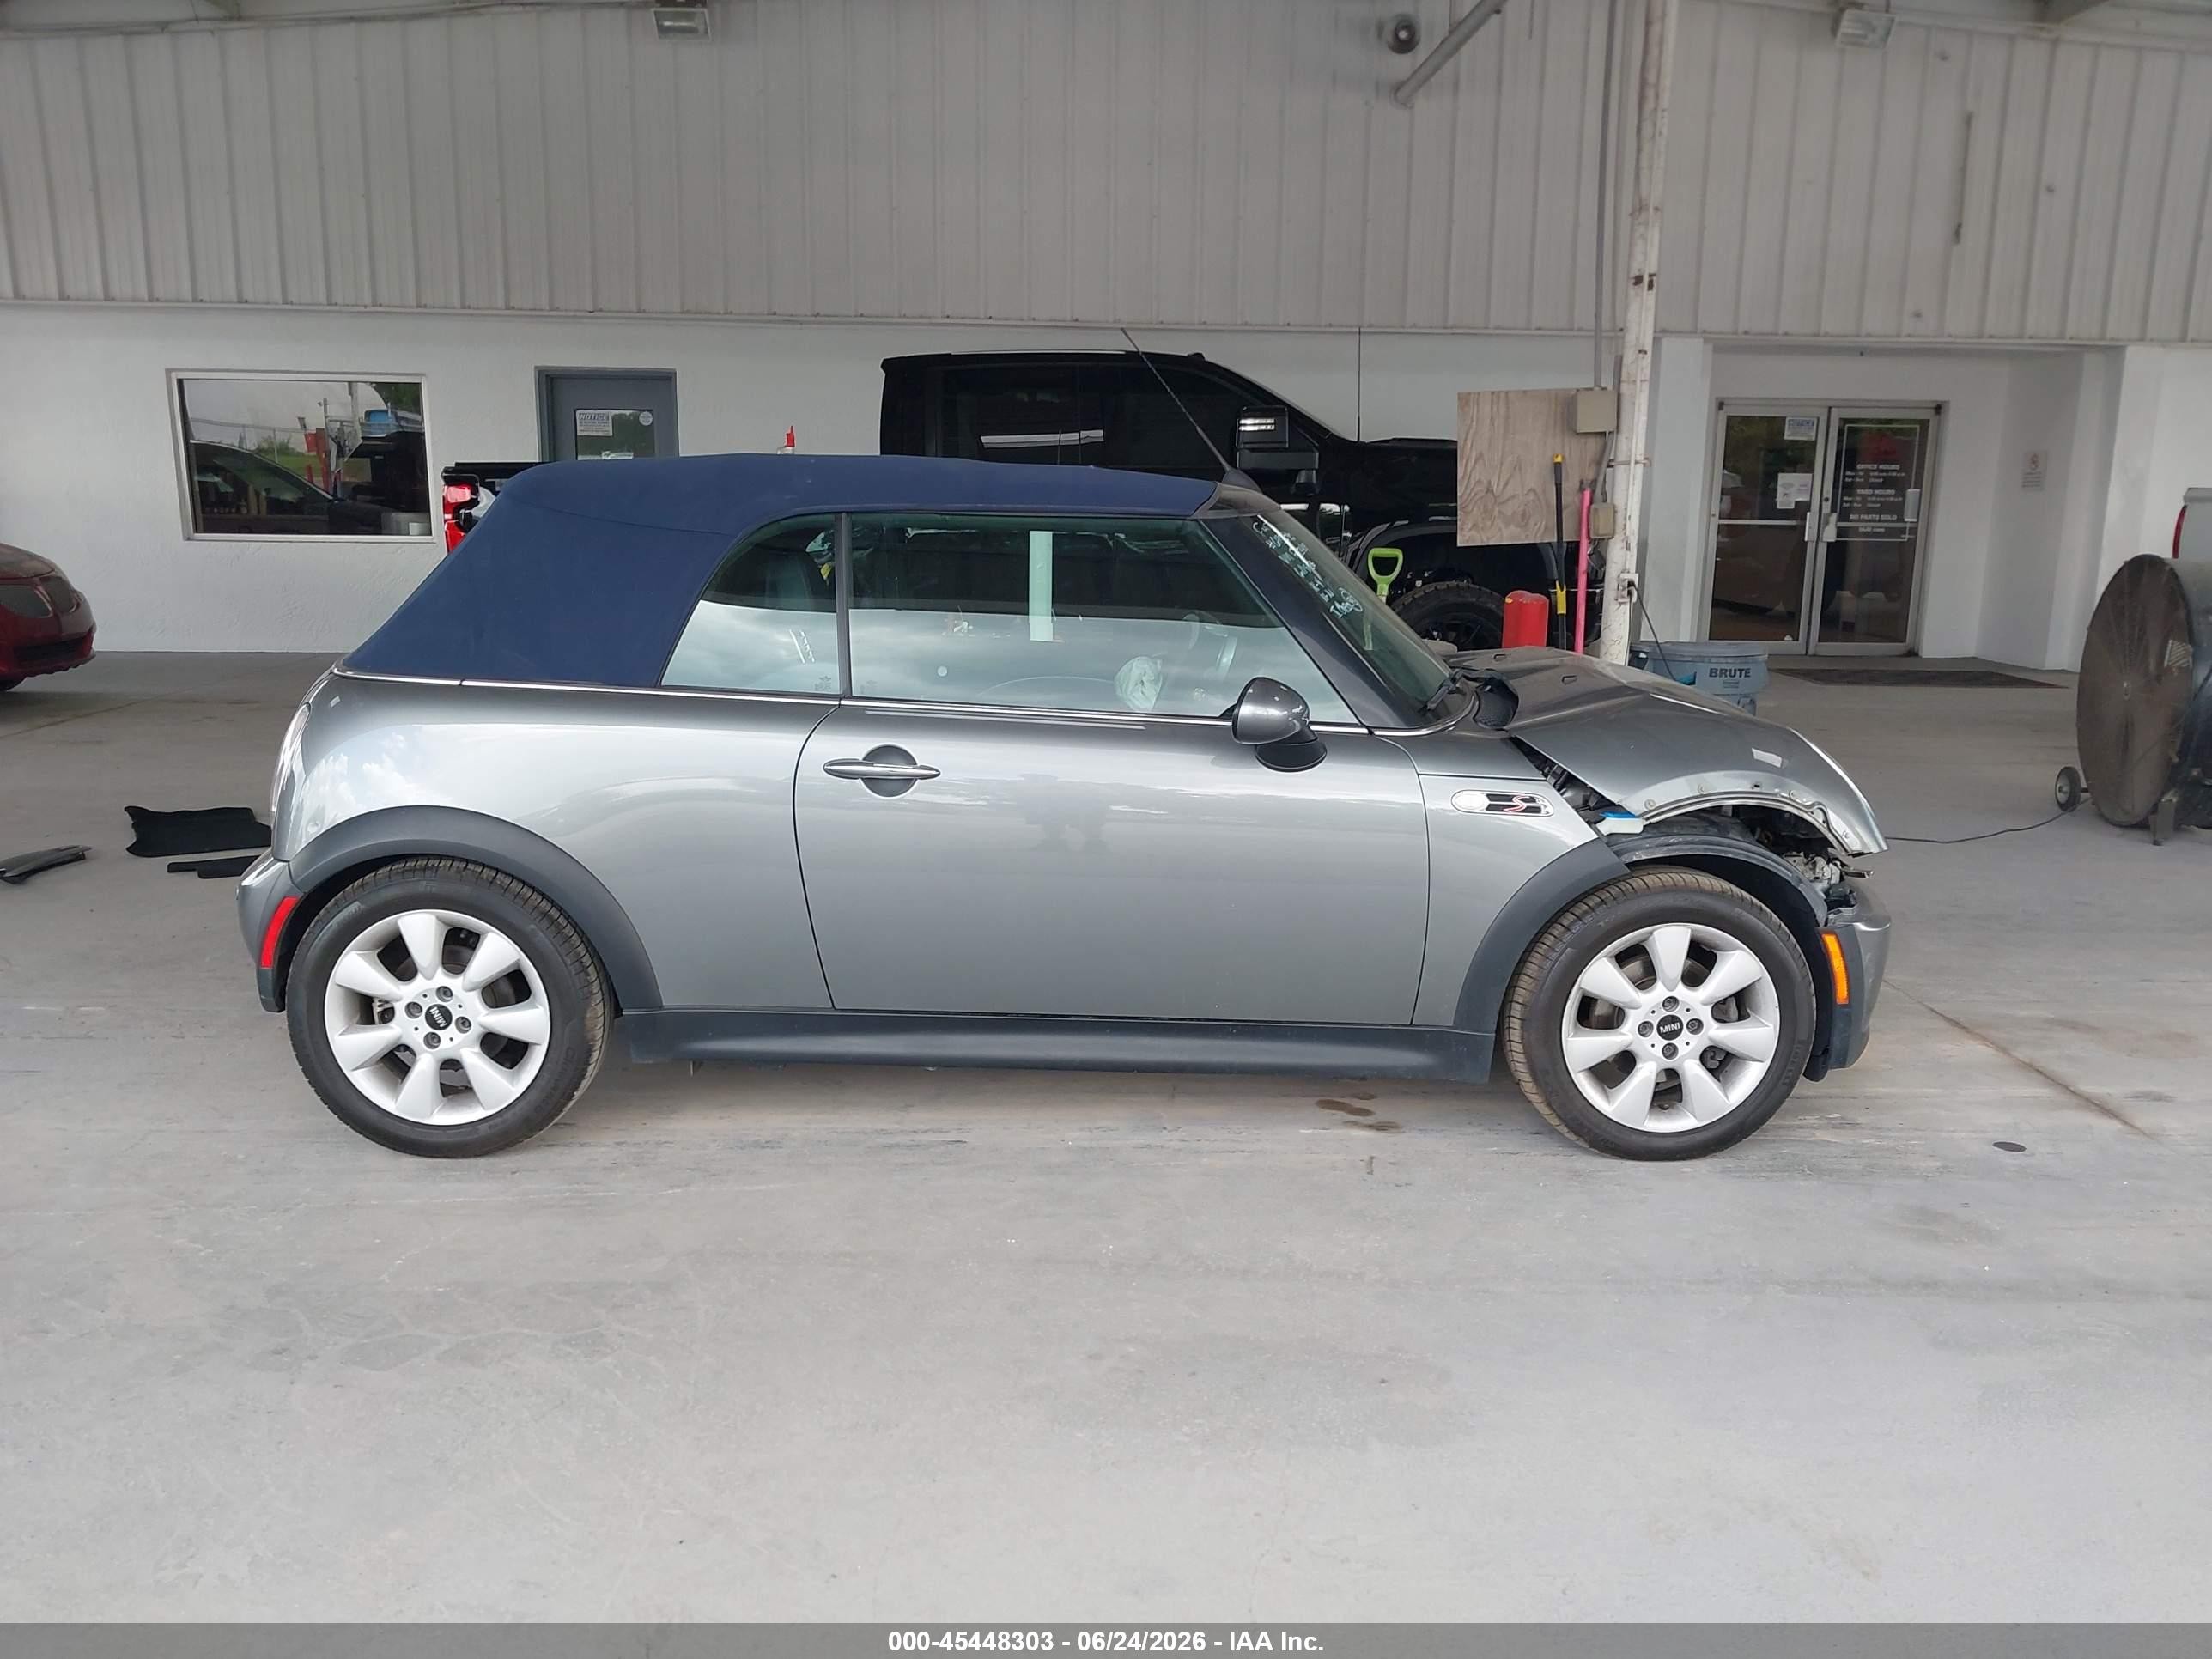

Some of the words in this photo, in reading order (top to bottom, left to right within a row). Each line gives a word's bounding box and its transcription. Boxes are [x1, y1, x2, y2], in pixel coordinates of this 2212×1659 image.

[1709, 667, 1751, 678] BRUTE
[429, 1006, 447, 1028] MINI
[1659, 1022, 1680, 1034] MINI
